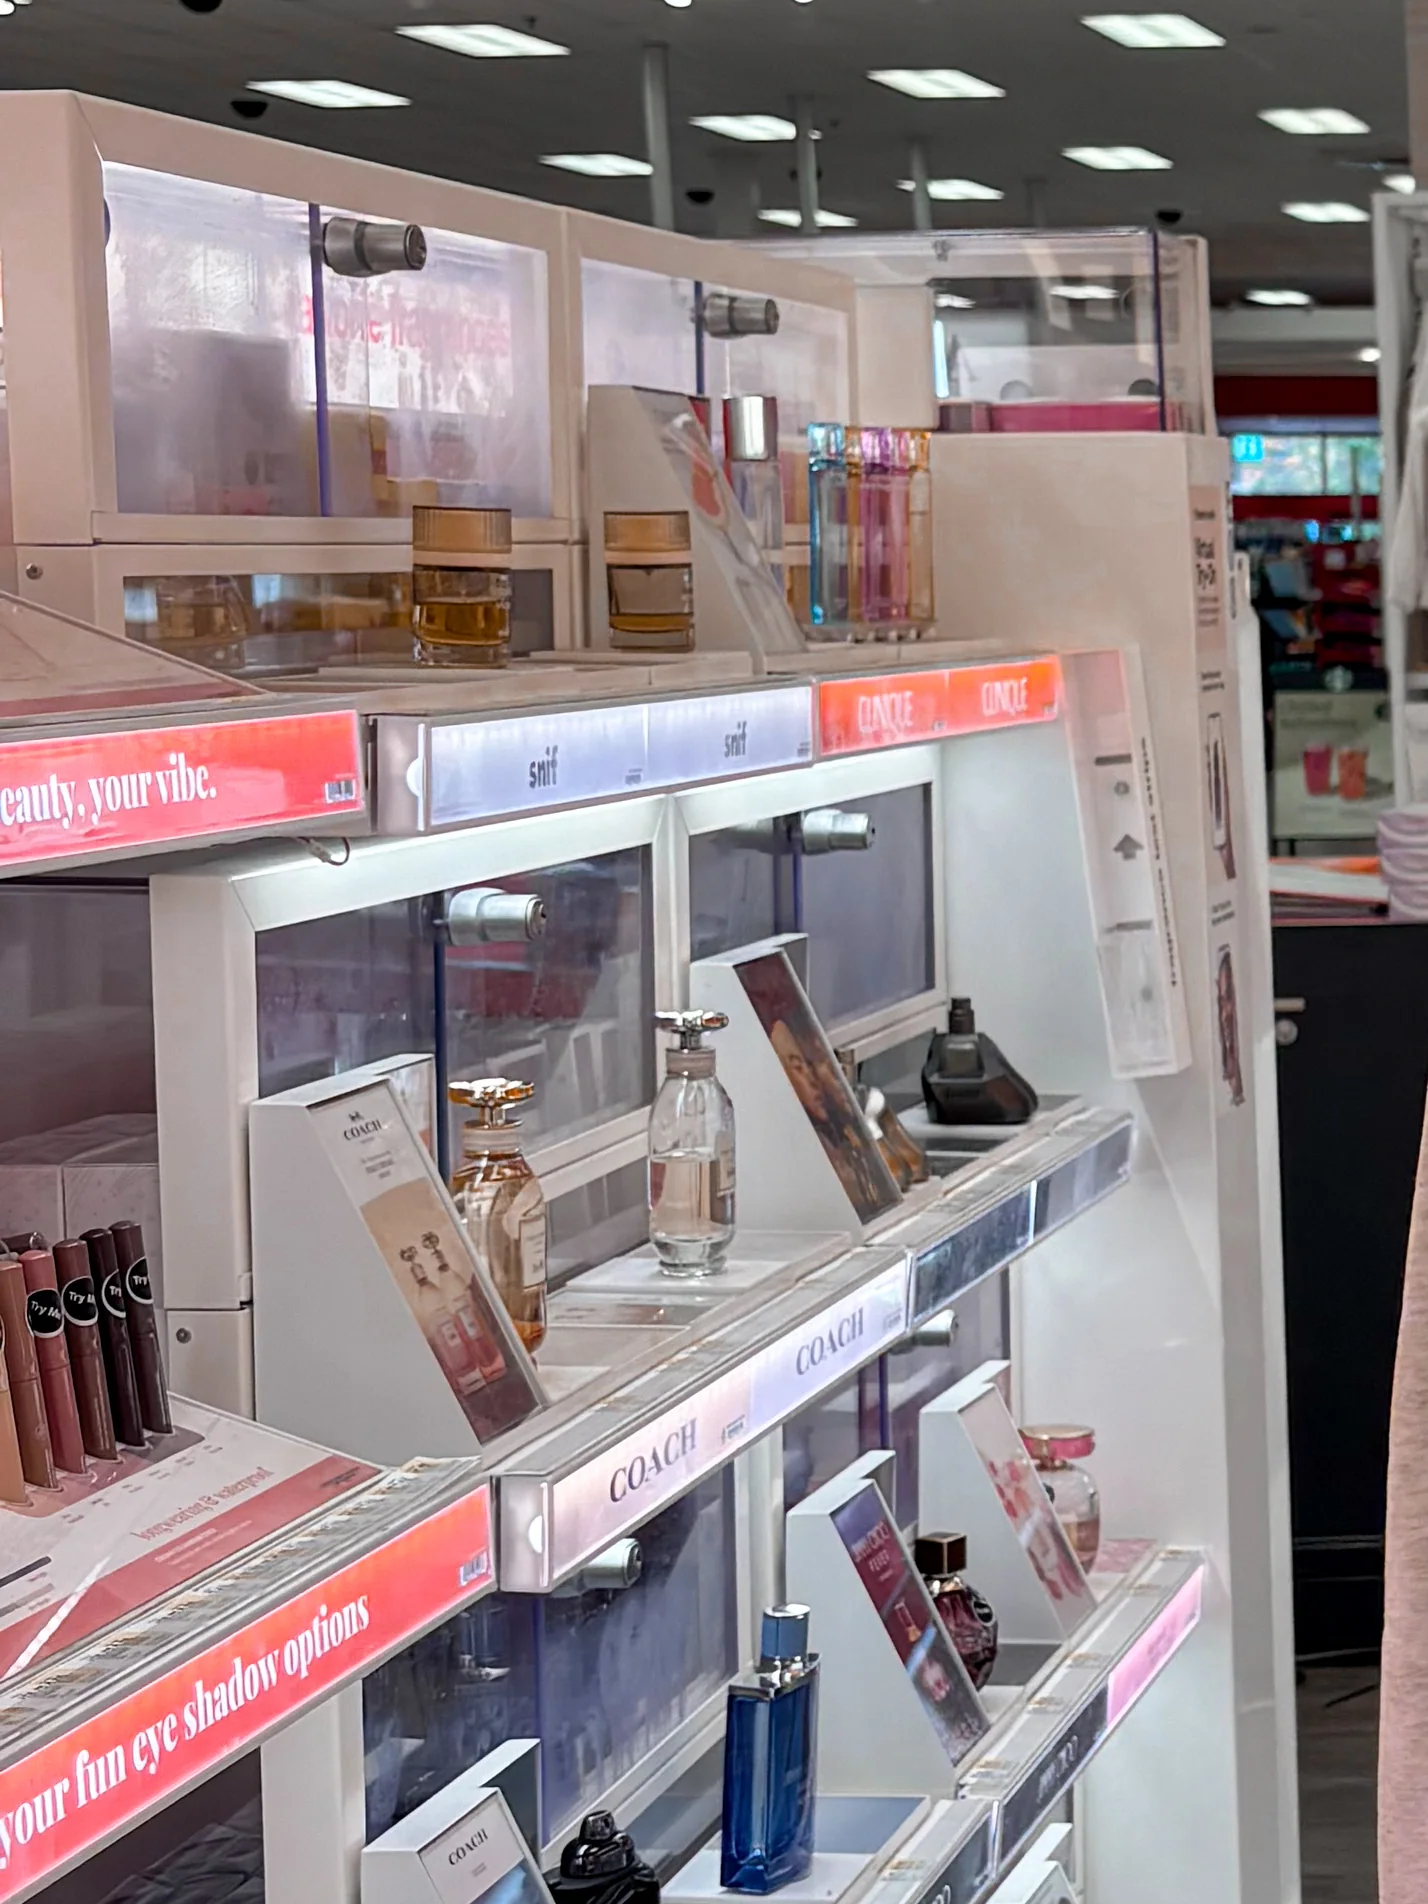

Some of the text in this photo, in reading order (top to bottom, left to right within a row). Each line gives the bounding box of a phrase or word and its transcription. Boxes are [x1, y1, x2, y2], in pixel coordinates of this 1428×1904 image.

[88, 772, 152, 826] your
[155, 752, 217, 808] vibe.
[527, 744, 560, 790] snif
[344, 1119, 382, 1141] COACH
[795, 1307, 864, 1376] COACH
[609, 1417, 698, 1504] COACH
[0, 1595, 370, 1870] your fun eye shadow options
[448, 1828, 488, 1865] COACH
